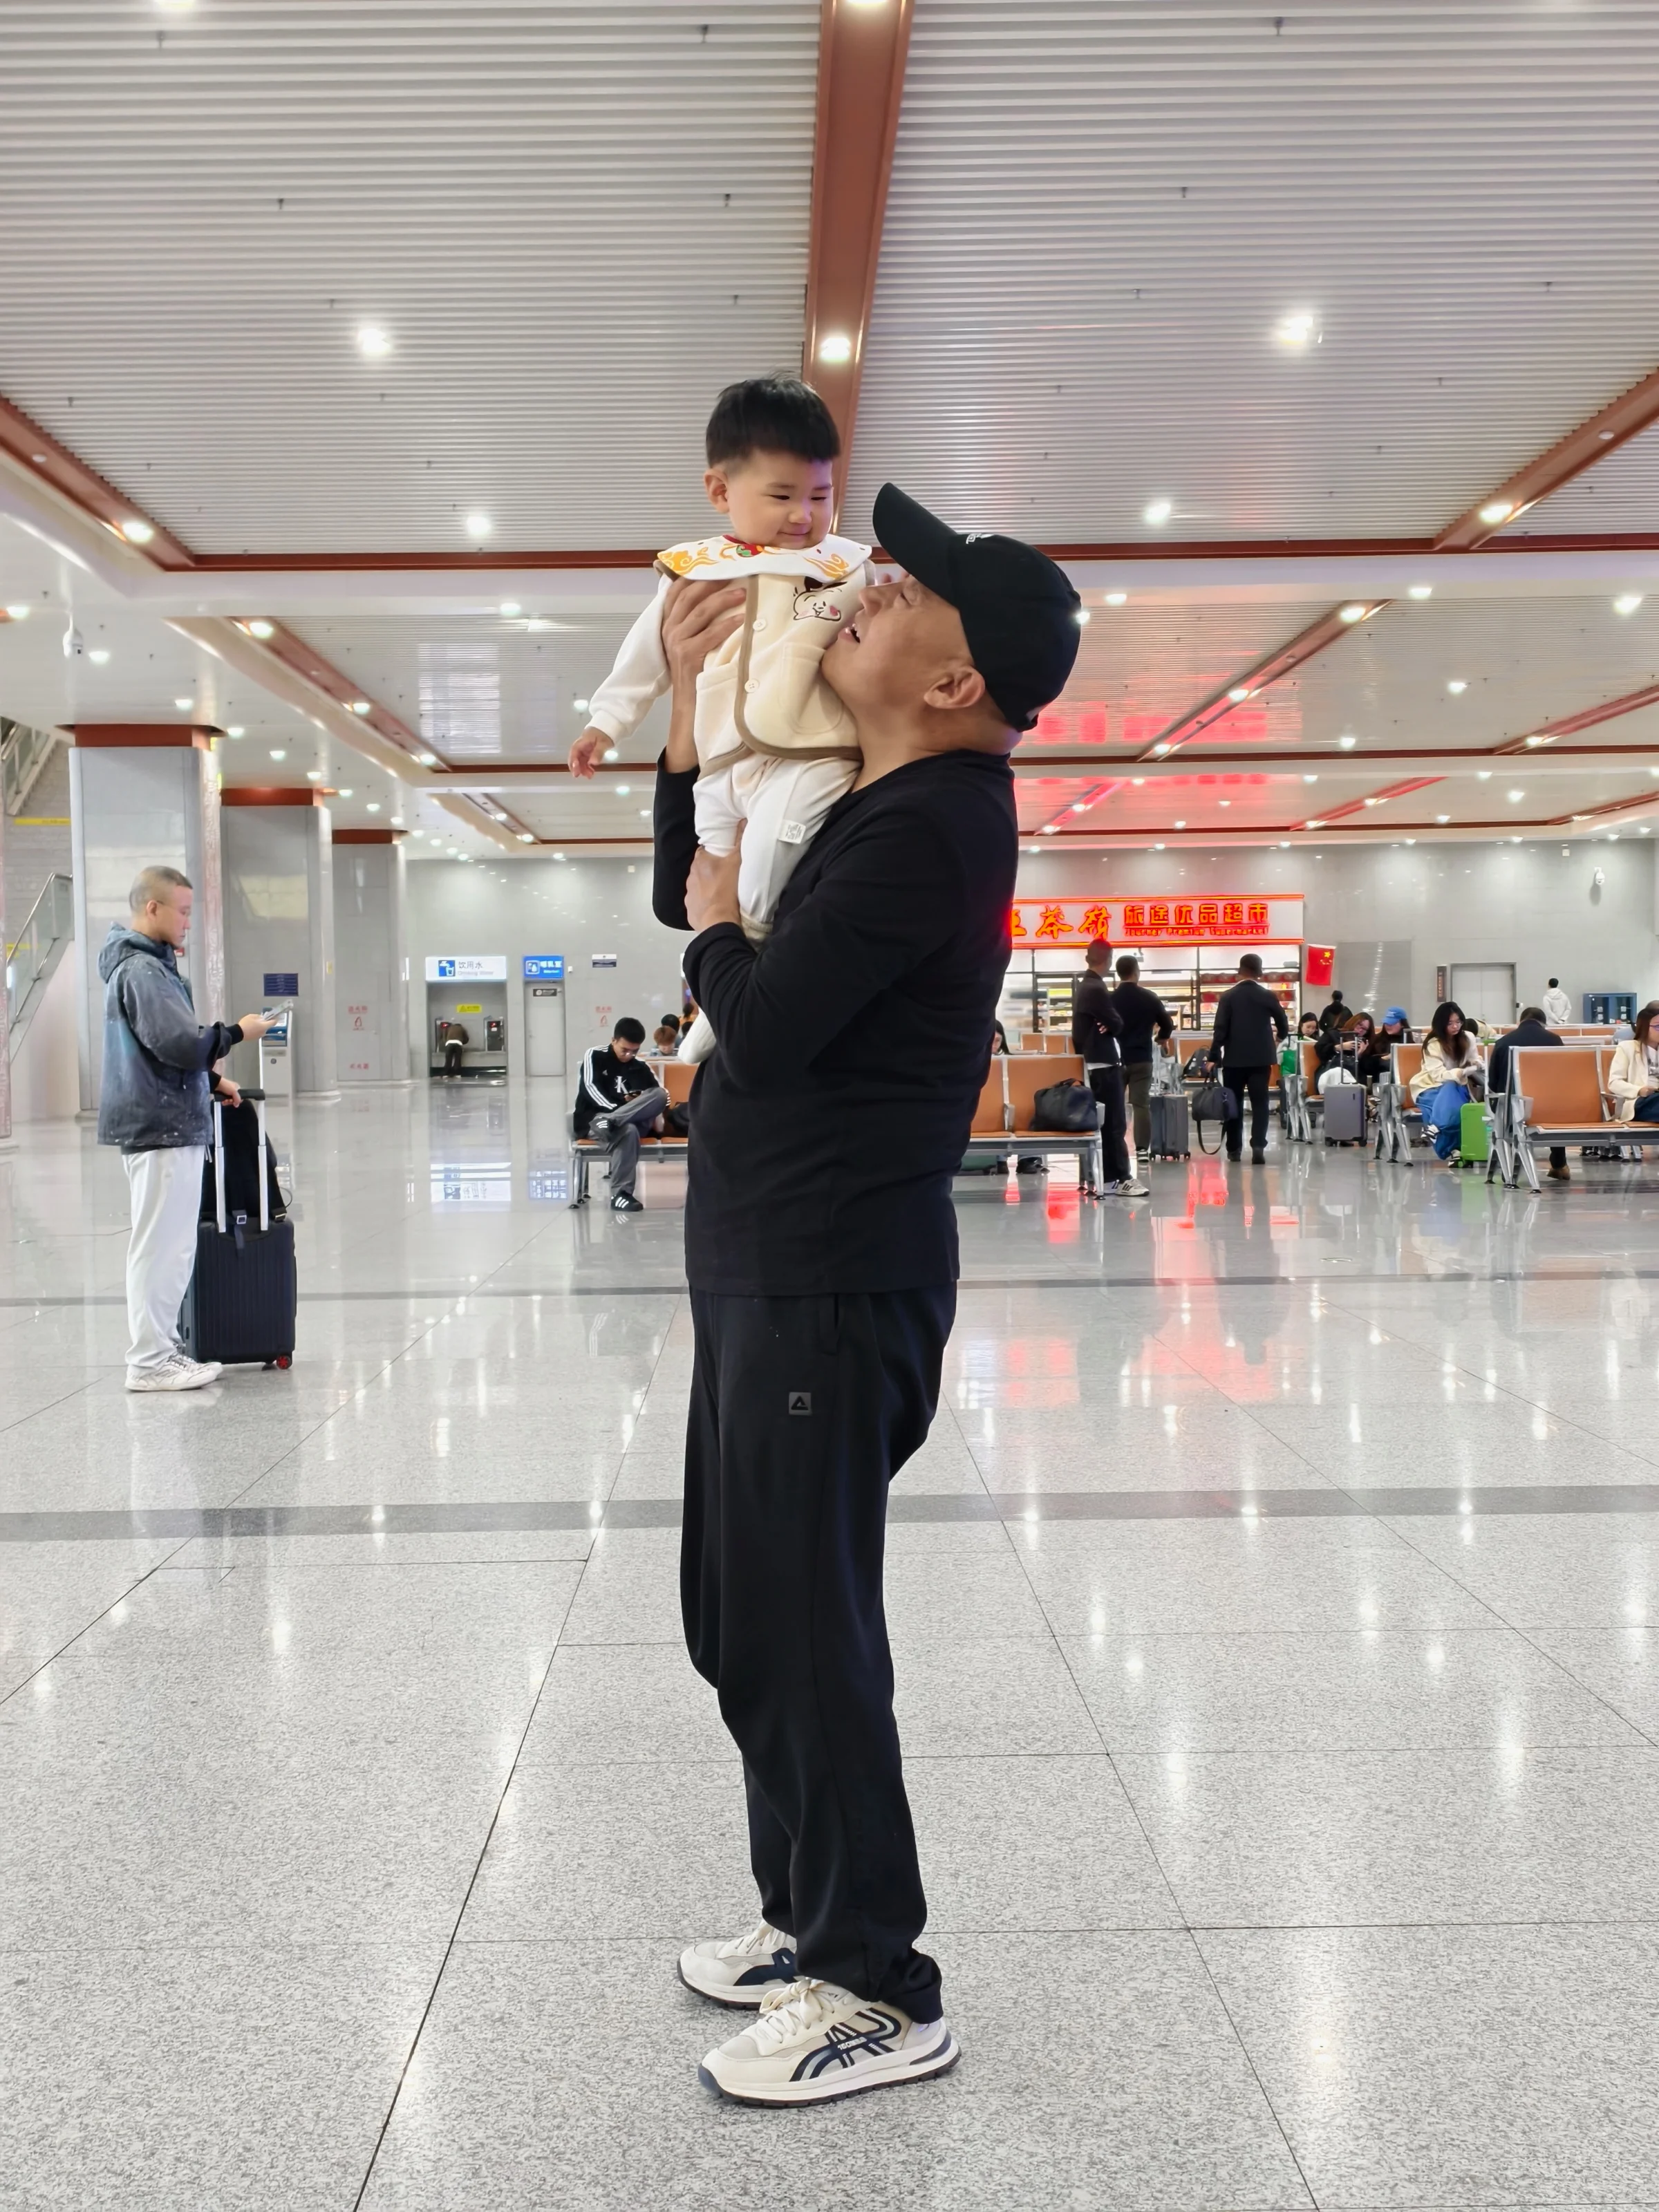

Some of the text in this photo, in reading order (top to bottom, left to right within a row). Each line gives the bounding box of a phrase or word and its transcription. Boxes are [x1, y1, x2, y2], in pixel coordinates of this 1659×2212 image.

[1124, 903, 1268, 924] 旅途优品超市
[458, 961, 483, 969] 饮用水
